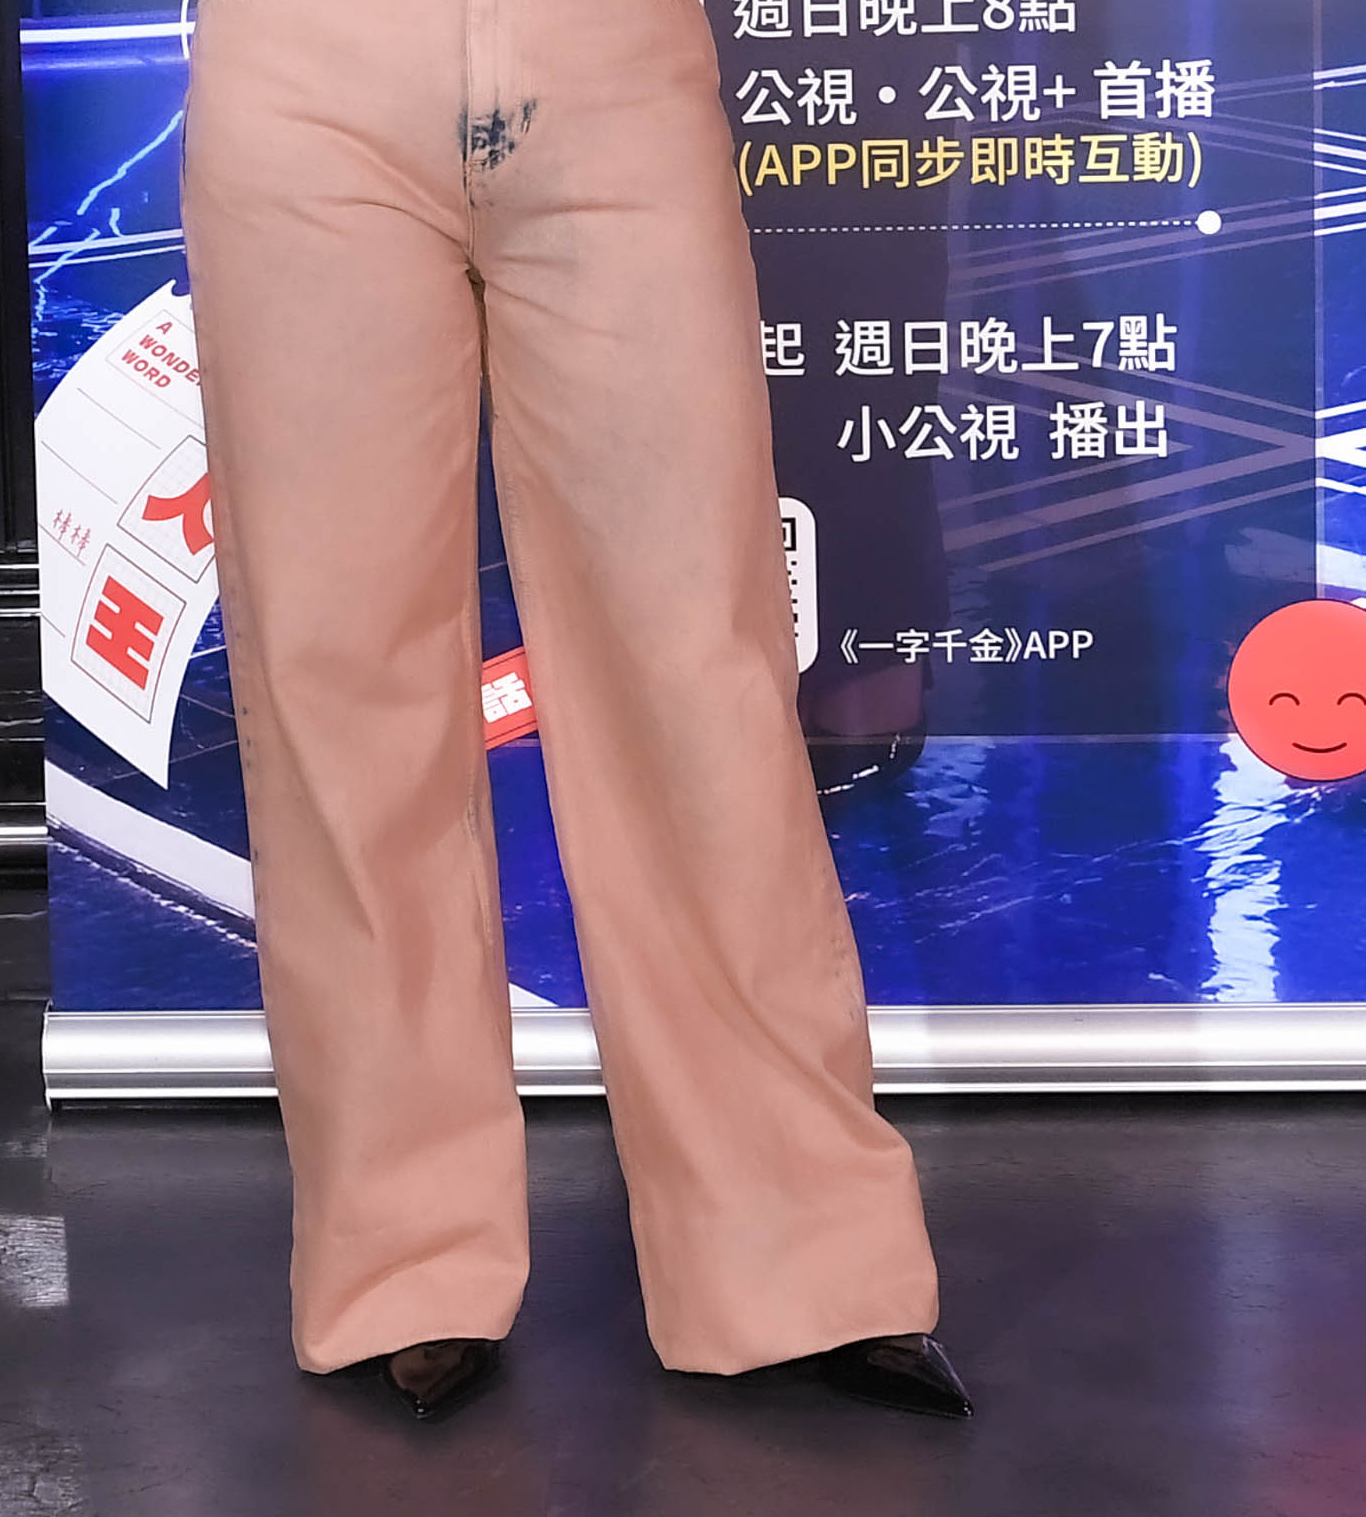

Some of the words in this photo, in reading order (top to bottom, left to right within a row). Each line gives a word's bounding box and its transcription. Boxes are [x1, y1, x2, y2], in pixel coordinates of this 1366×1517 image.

[1092, 59, 1217, 120] 首播
[738, 131, 1204, 196] (APP同步即時互動)
[156, 320, 174, 336] A
[834, 313, 1179, 376] 週日晚上7點
[121, 349, 173, 390] WORD
[138, 333, 203, 388] WONDE
[837, 403, 1021, 463] 小公視
[1049, 400, 1170, 460] 播出
[839, 628, 1094, 665] 《一字千金》APP
